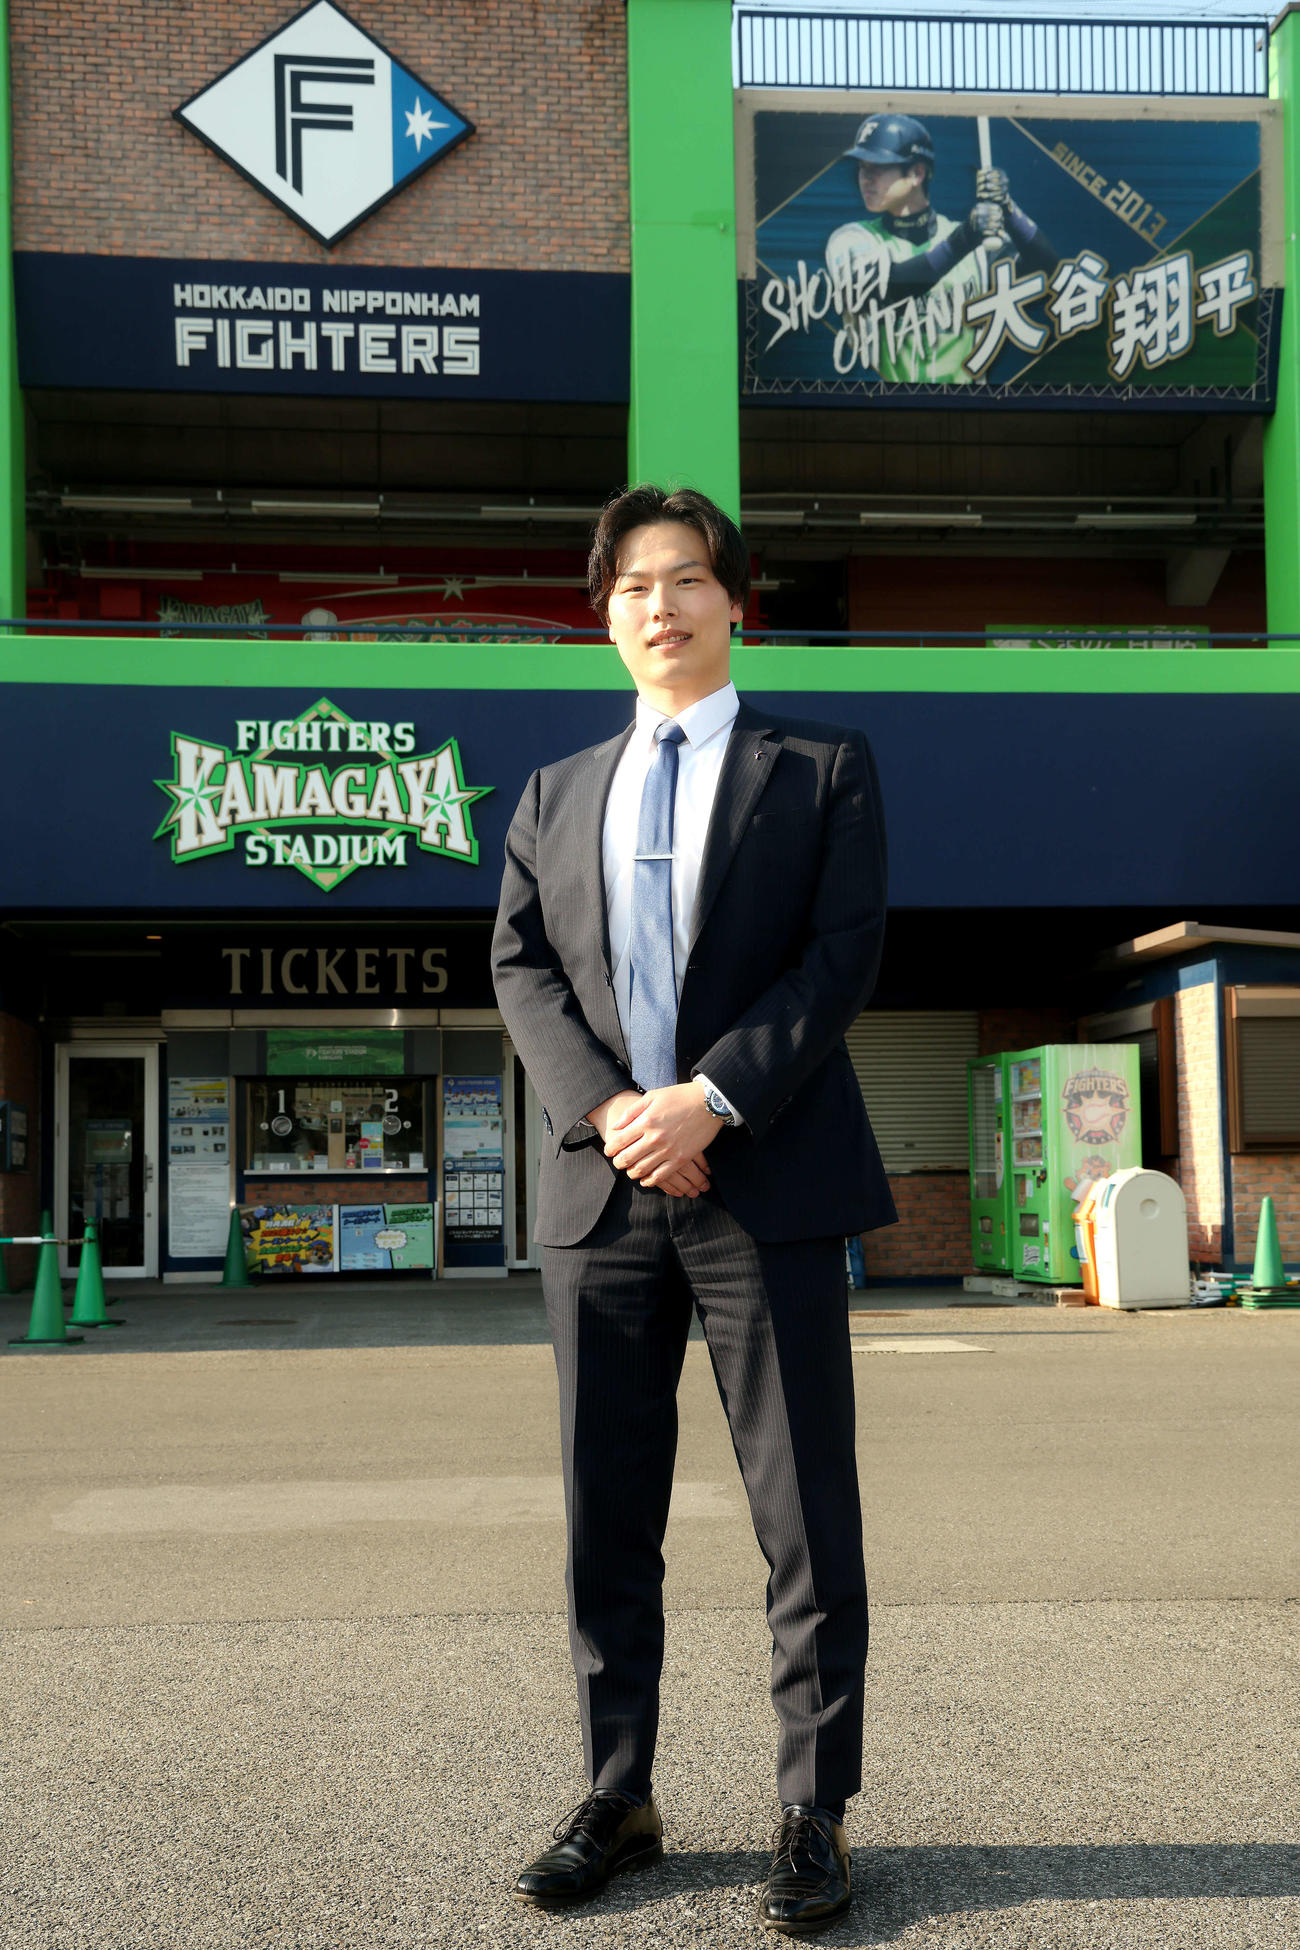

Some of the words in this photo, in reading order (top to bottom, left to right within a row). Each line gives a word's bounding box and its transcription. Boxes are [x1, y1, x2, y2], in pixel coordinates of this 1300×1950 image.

[274, 54, 375, 196] F
[1052, 141, 1107, 196] SINCE
[1104, 180, 1168, 241] 2013
[174, 283, 310, 312] HOKKAIDO
[323, 288, 480, 317] NIPPONHAM
[762, 245, 890, 351] SHOHEI
[965, 250, 1256, 379] 大谷翔平
[174, 317, 480, 376] FIGHTERS
[832, 282, 966, 374] OHTANI
[237, 720, 416, 753] FIGHTERS
[174, 738, 473, 856] KAMAGAYA
[246, 834, 407, 867] STADIUM
[222, 947, 449, 995] TICKETS
[278, 1089, 286, 1113] 1
[384, 1088, 399, 1113] 2
[1064, 1077, 1129, 1097] FIGHTERS
